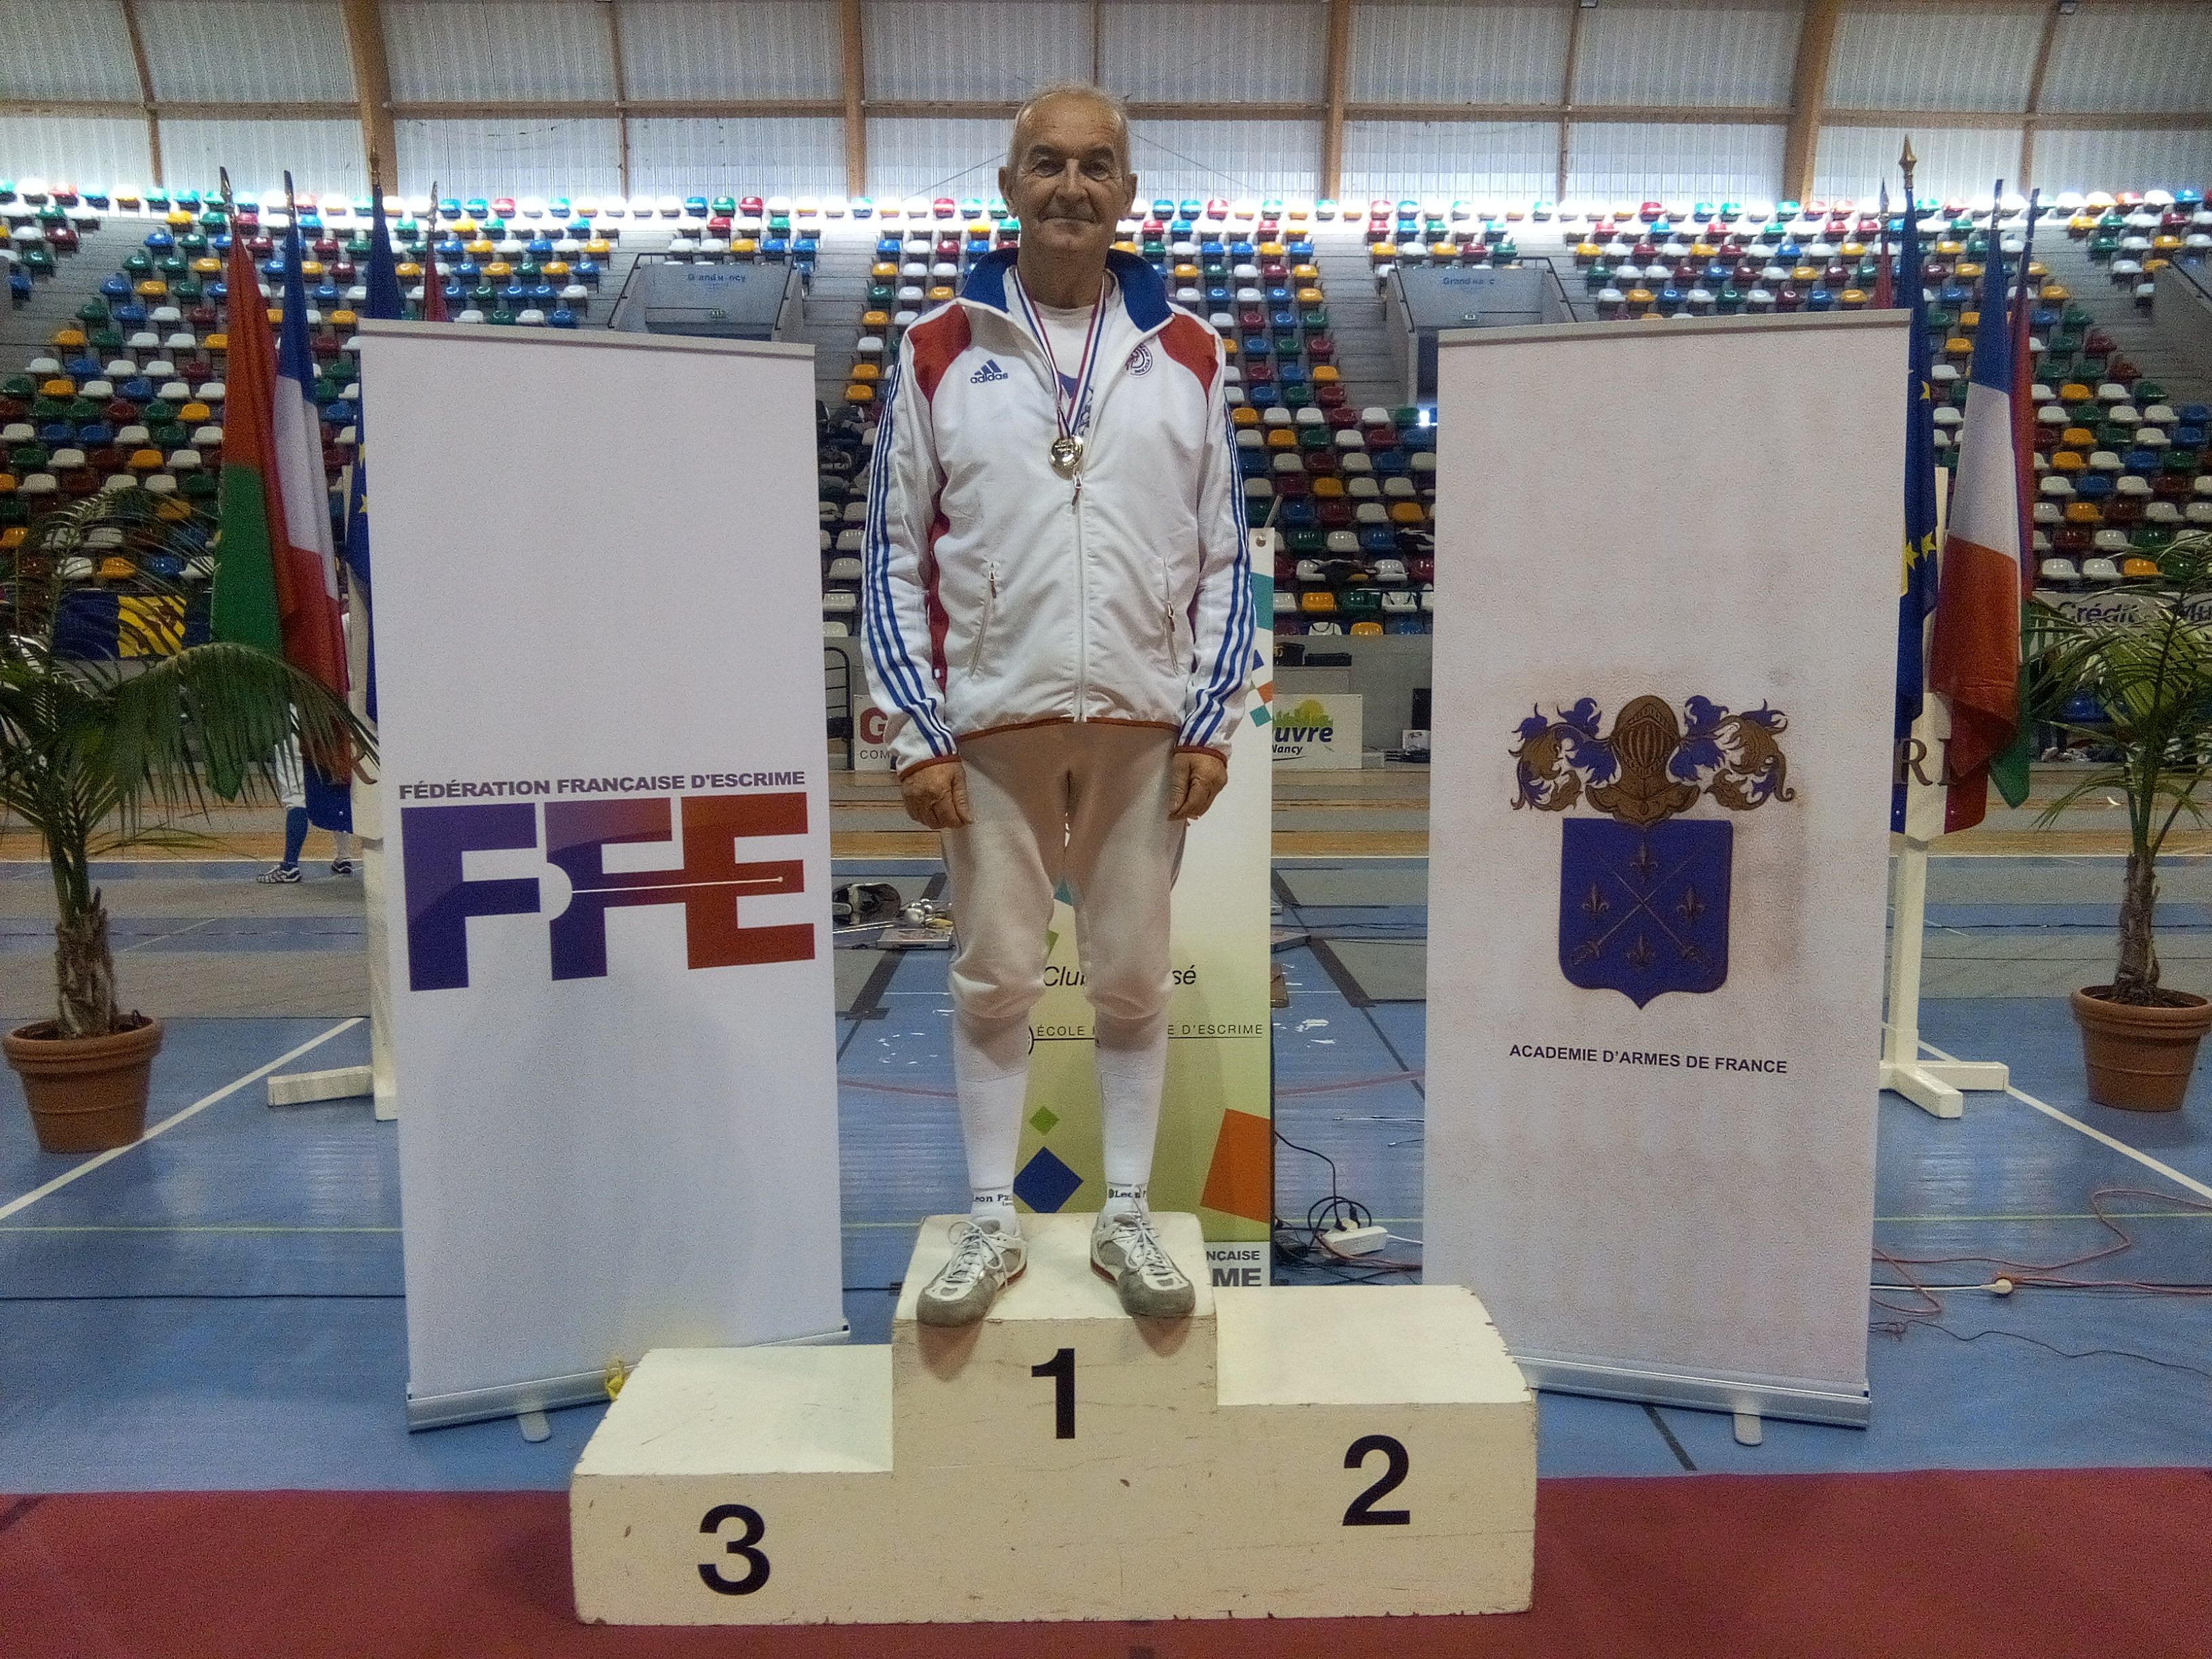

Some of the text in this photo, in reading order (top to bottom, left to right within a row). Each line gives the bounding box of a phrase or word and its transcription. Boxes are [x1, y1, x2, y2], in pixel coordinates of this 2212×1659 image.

[970, 372, 1008, 384] adidas
[860, 707, 888, 744] G
[1273, 726, 1333, 743] uvre
[860, 750, 890, 760] COM
[399, 771, 805, 799] FÉDÉRATION FRANÇAISE D'ESCRIME
[401, 792, 815, 992] FFE
[1038, 1025, 1085, 1036] ÉCOLE
[1182, 1024, 1263, 1035] D'ESCRIME
[1509, 1044, 1788, 1074] ACADEMIE D'ARMES DE FRANCE
[1206, 1250, 1261, 1261] NÇAISE
[1212, 1268, 1262, 1287] ME
[1031, 1348, 1075, 1439] 1
[1343, 1435, 1410, 1526] 2
[698, 1504, 770, 1595] 3
